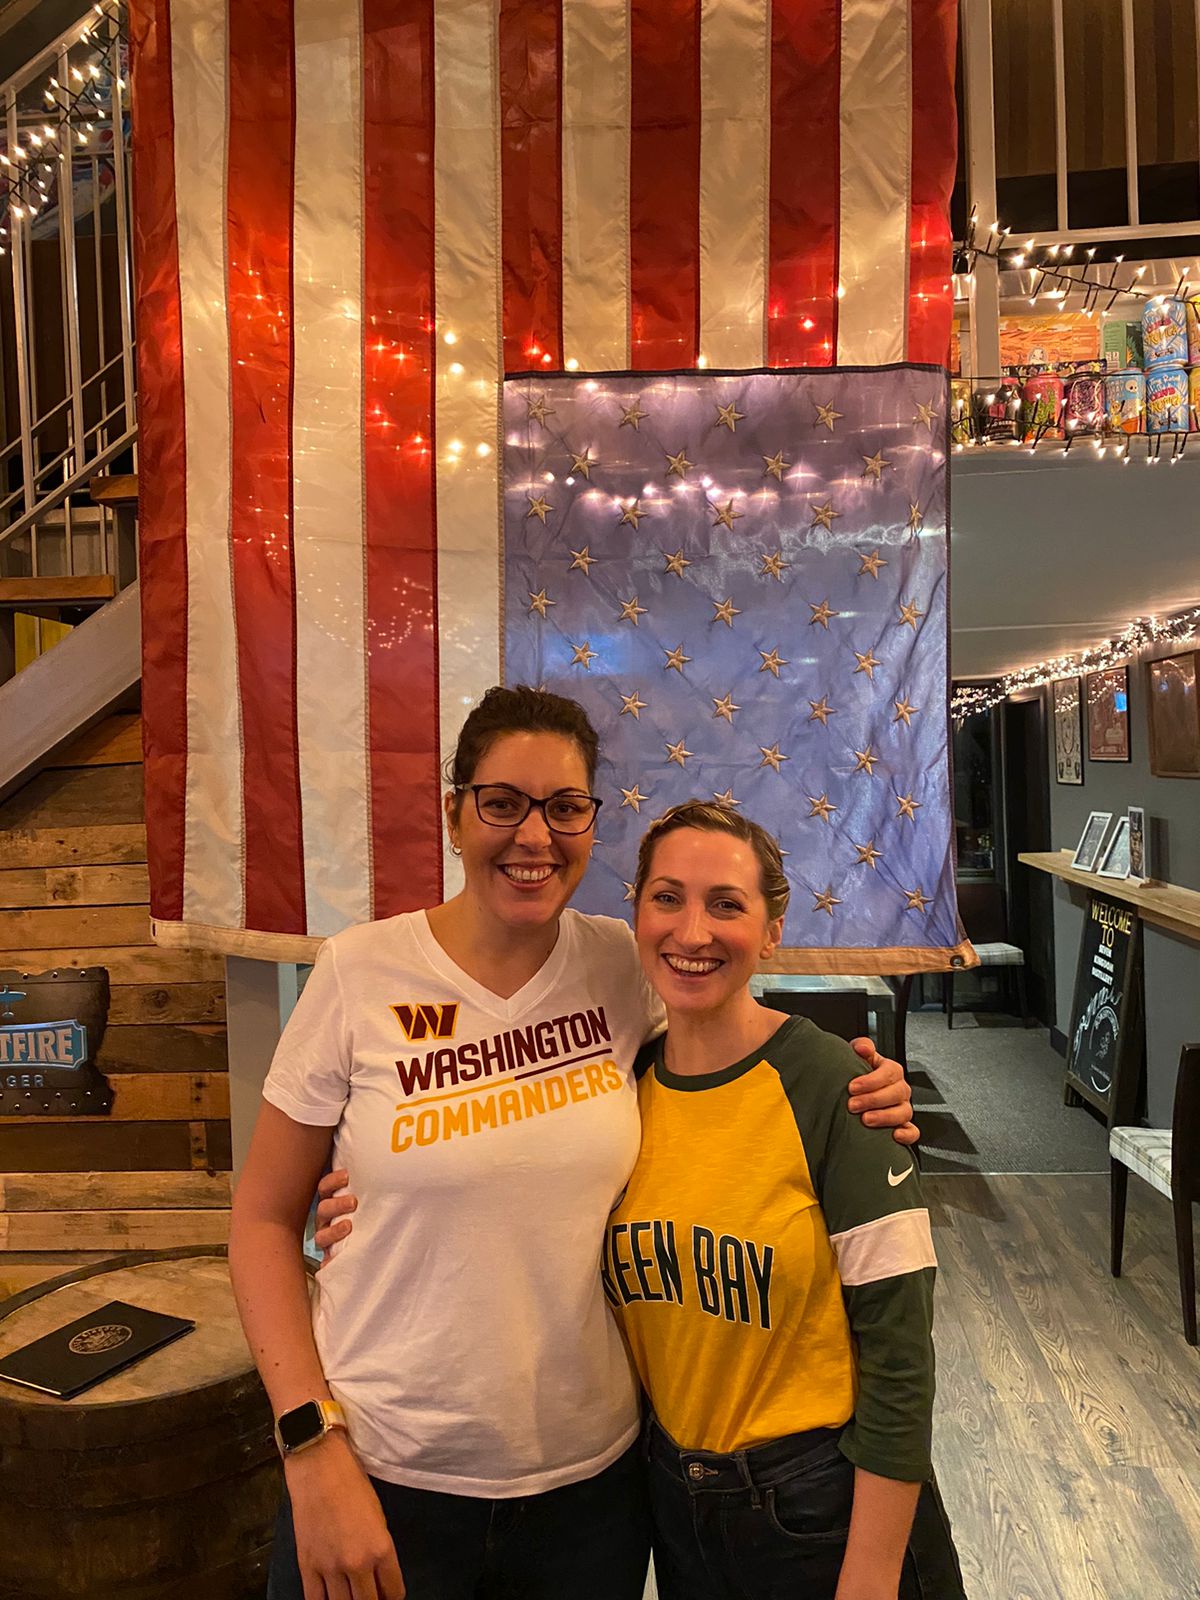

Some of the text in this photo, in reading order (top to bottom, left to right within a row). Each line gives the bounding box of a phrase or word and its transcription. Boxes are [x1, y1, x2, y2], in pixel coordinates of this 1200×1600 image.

[1091, 902, 1133, 935] WELCOME
[1101, 924, 1115, 948] TO
[389, 1001, 461, 1042] W
[395, 1006, 612, 1096] WASHINGTON
[0, 1074, 44, 1088] GER
[391, 1059, 622, 1153] COMMANDERS
[692, 1224, 774, 1331] BAY
